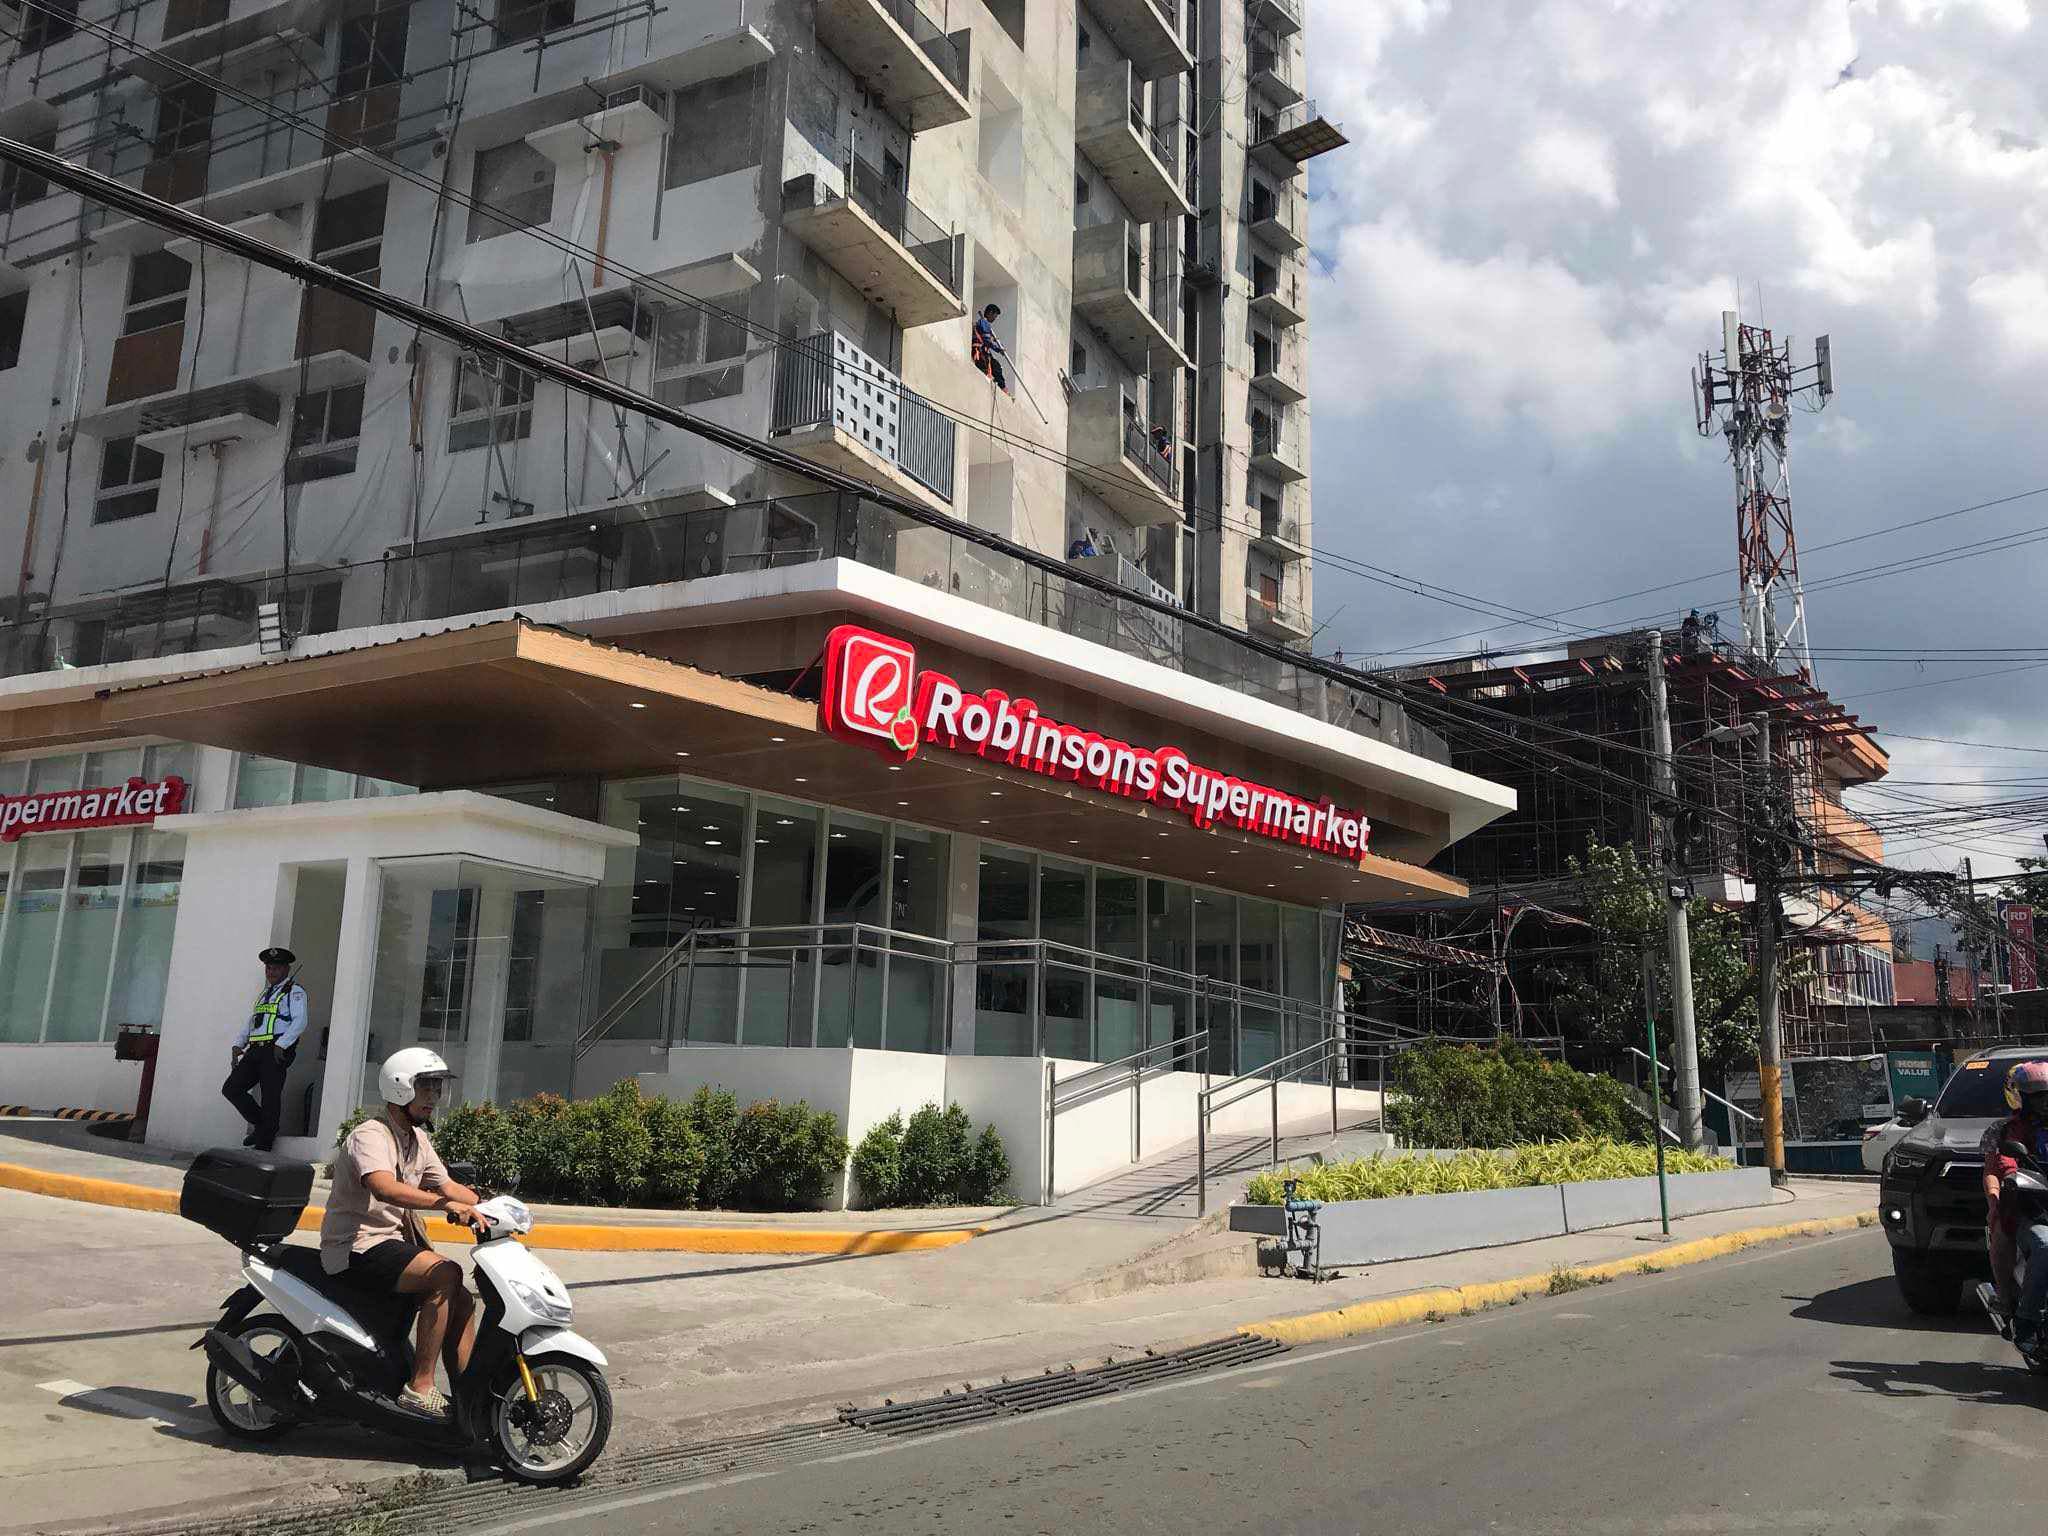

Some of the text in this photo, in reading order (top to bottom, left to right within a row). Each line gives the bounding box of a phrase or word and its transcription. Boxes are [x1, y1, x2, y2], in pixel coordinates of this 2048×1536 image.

[926, 681, 1371, 851] Robinsons Supermarket
[0, 781, 170, 834] permarket
[1897, 1068, 1930, 1077] VALUE
